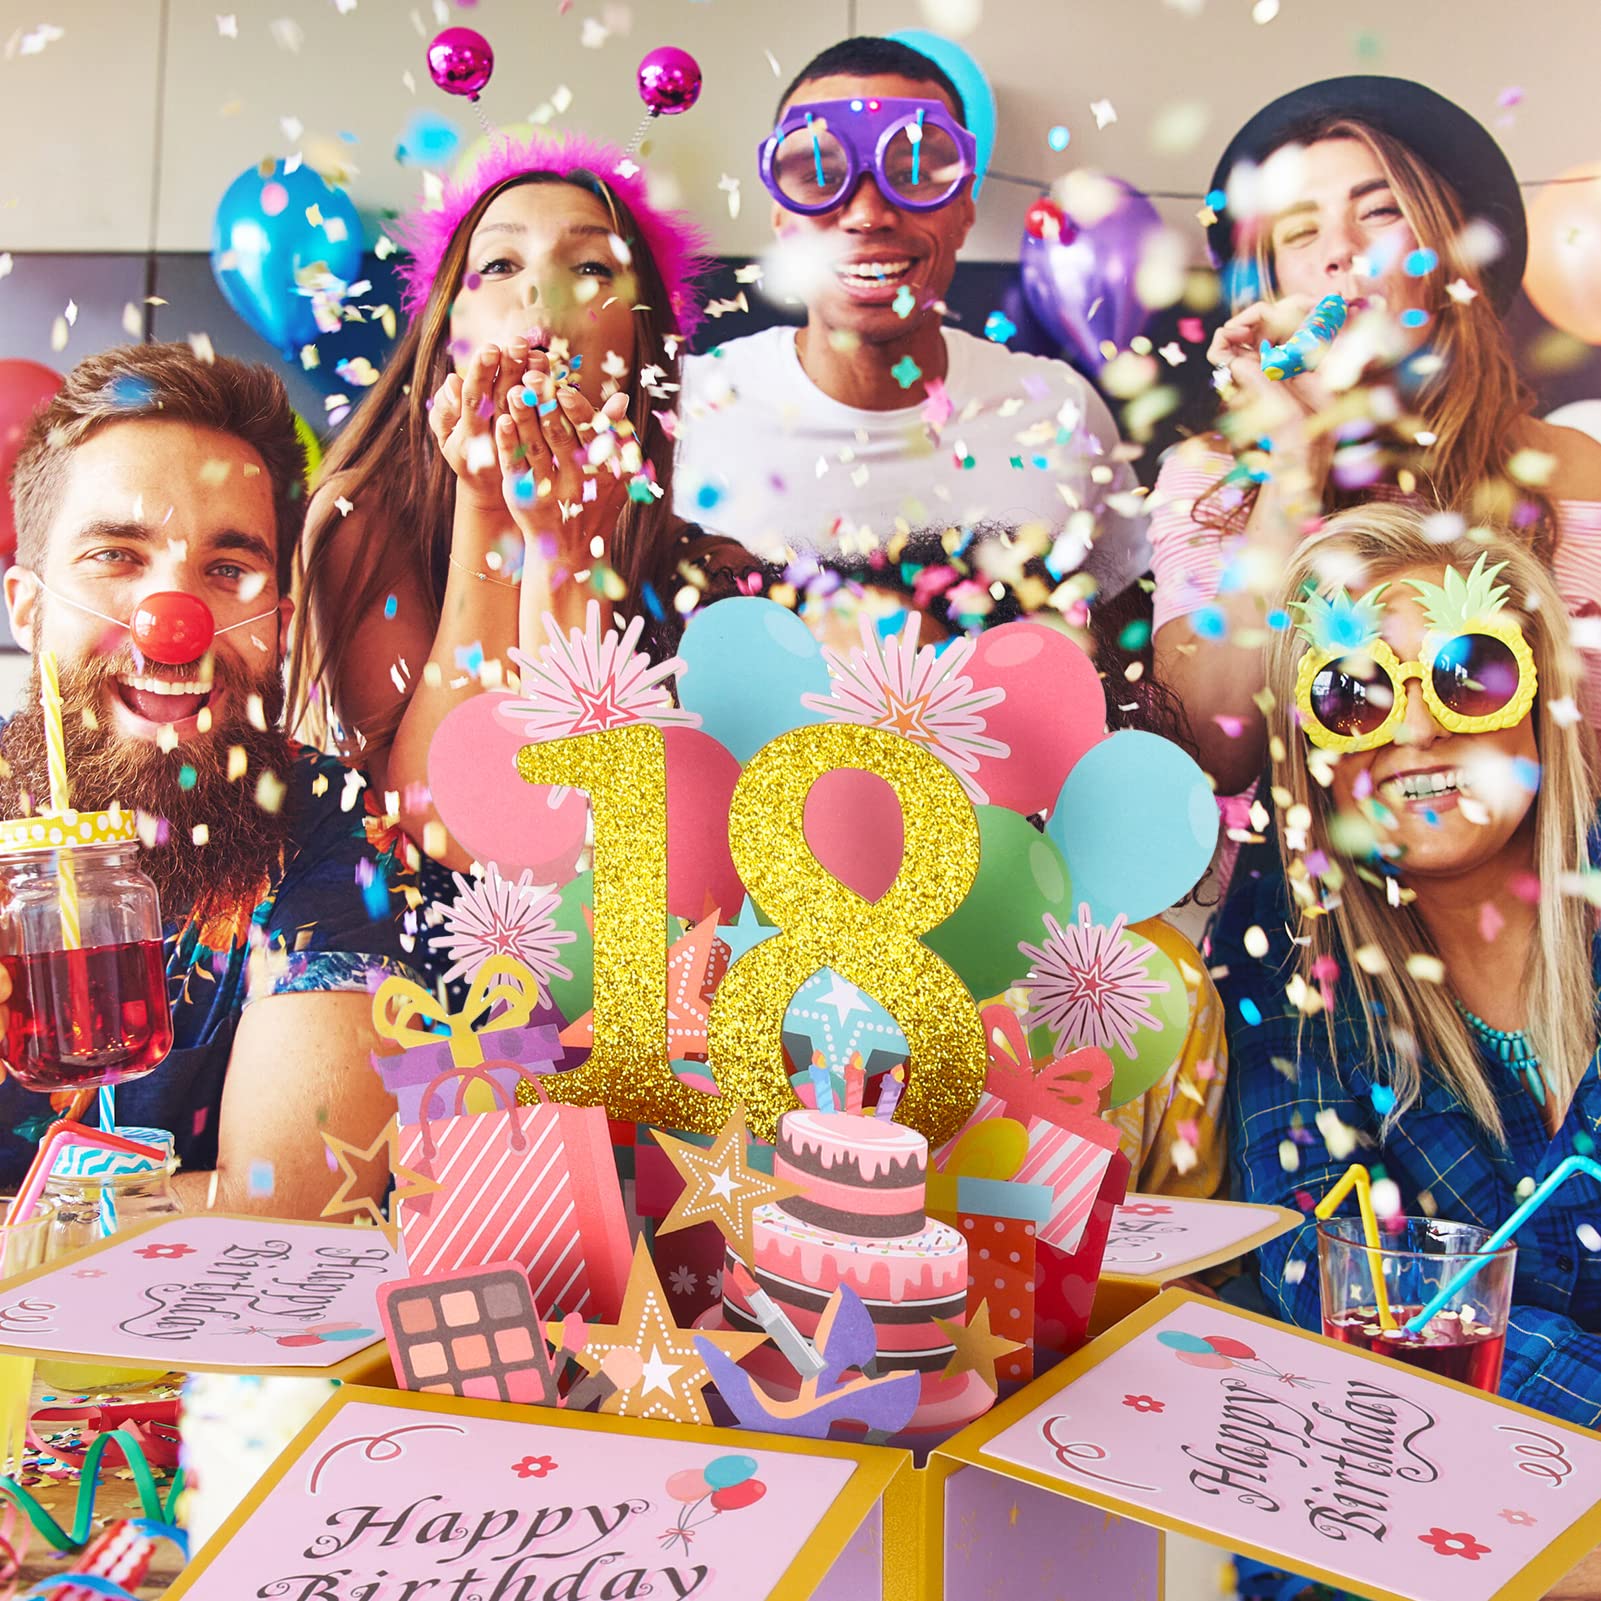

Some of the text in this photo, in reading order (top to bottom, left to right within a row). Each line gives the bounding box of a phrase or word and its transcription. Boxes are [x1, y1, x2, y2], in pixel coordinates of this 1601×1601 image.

[515, 722, 988, 1148] 18
[119, 1239, 293, 1341] Birthday
[248, 1247, 390, 1322] Happy
[1180, 1377, 1315, 1513] Happy
[1304, 1379, 1439, 1543] Birthday
[302, 1494, 651, 1564] Happy
